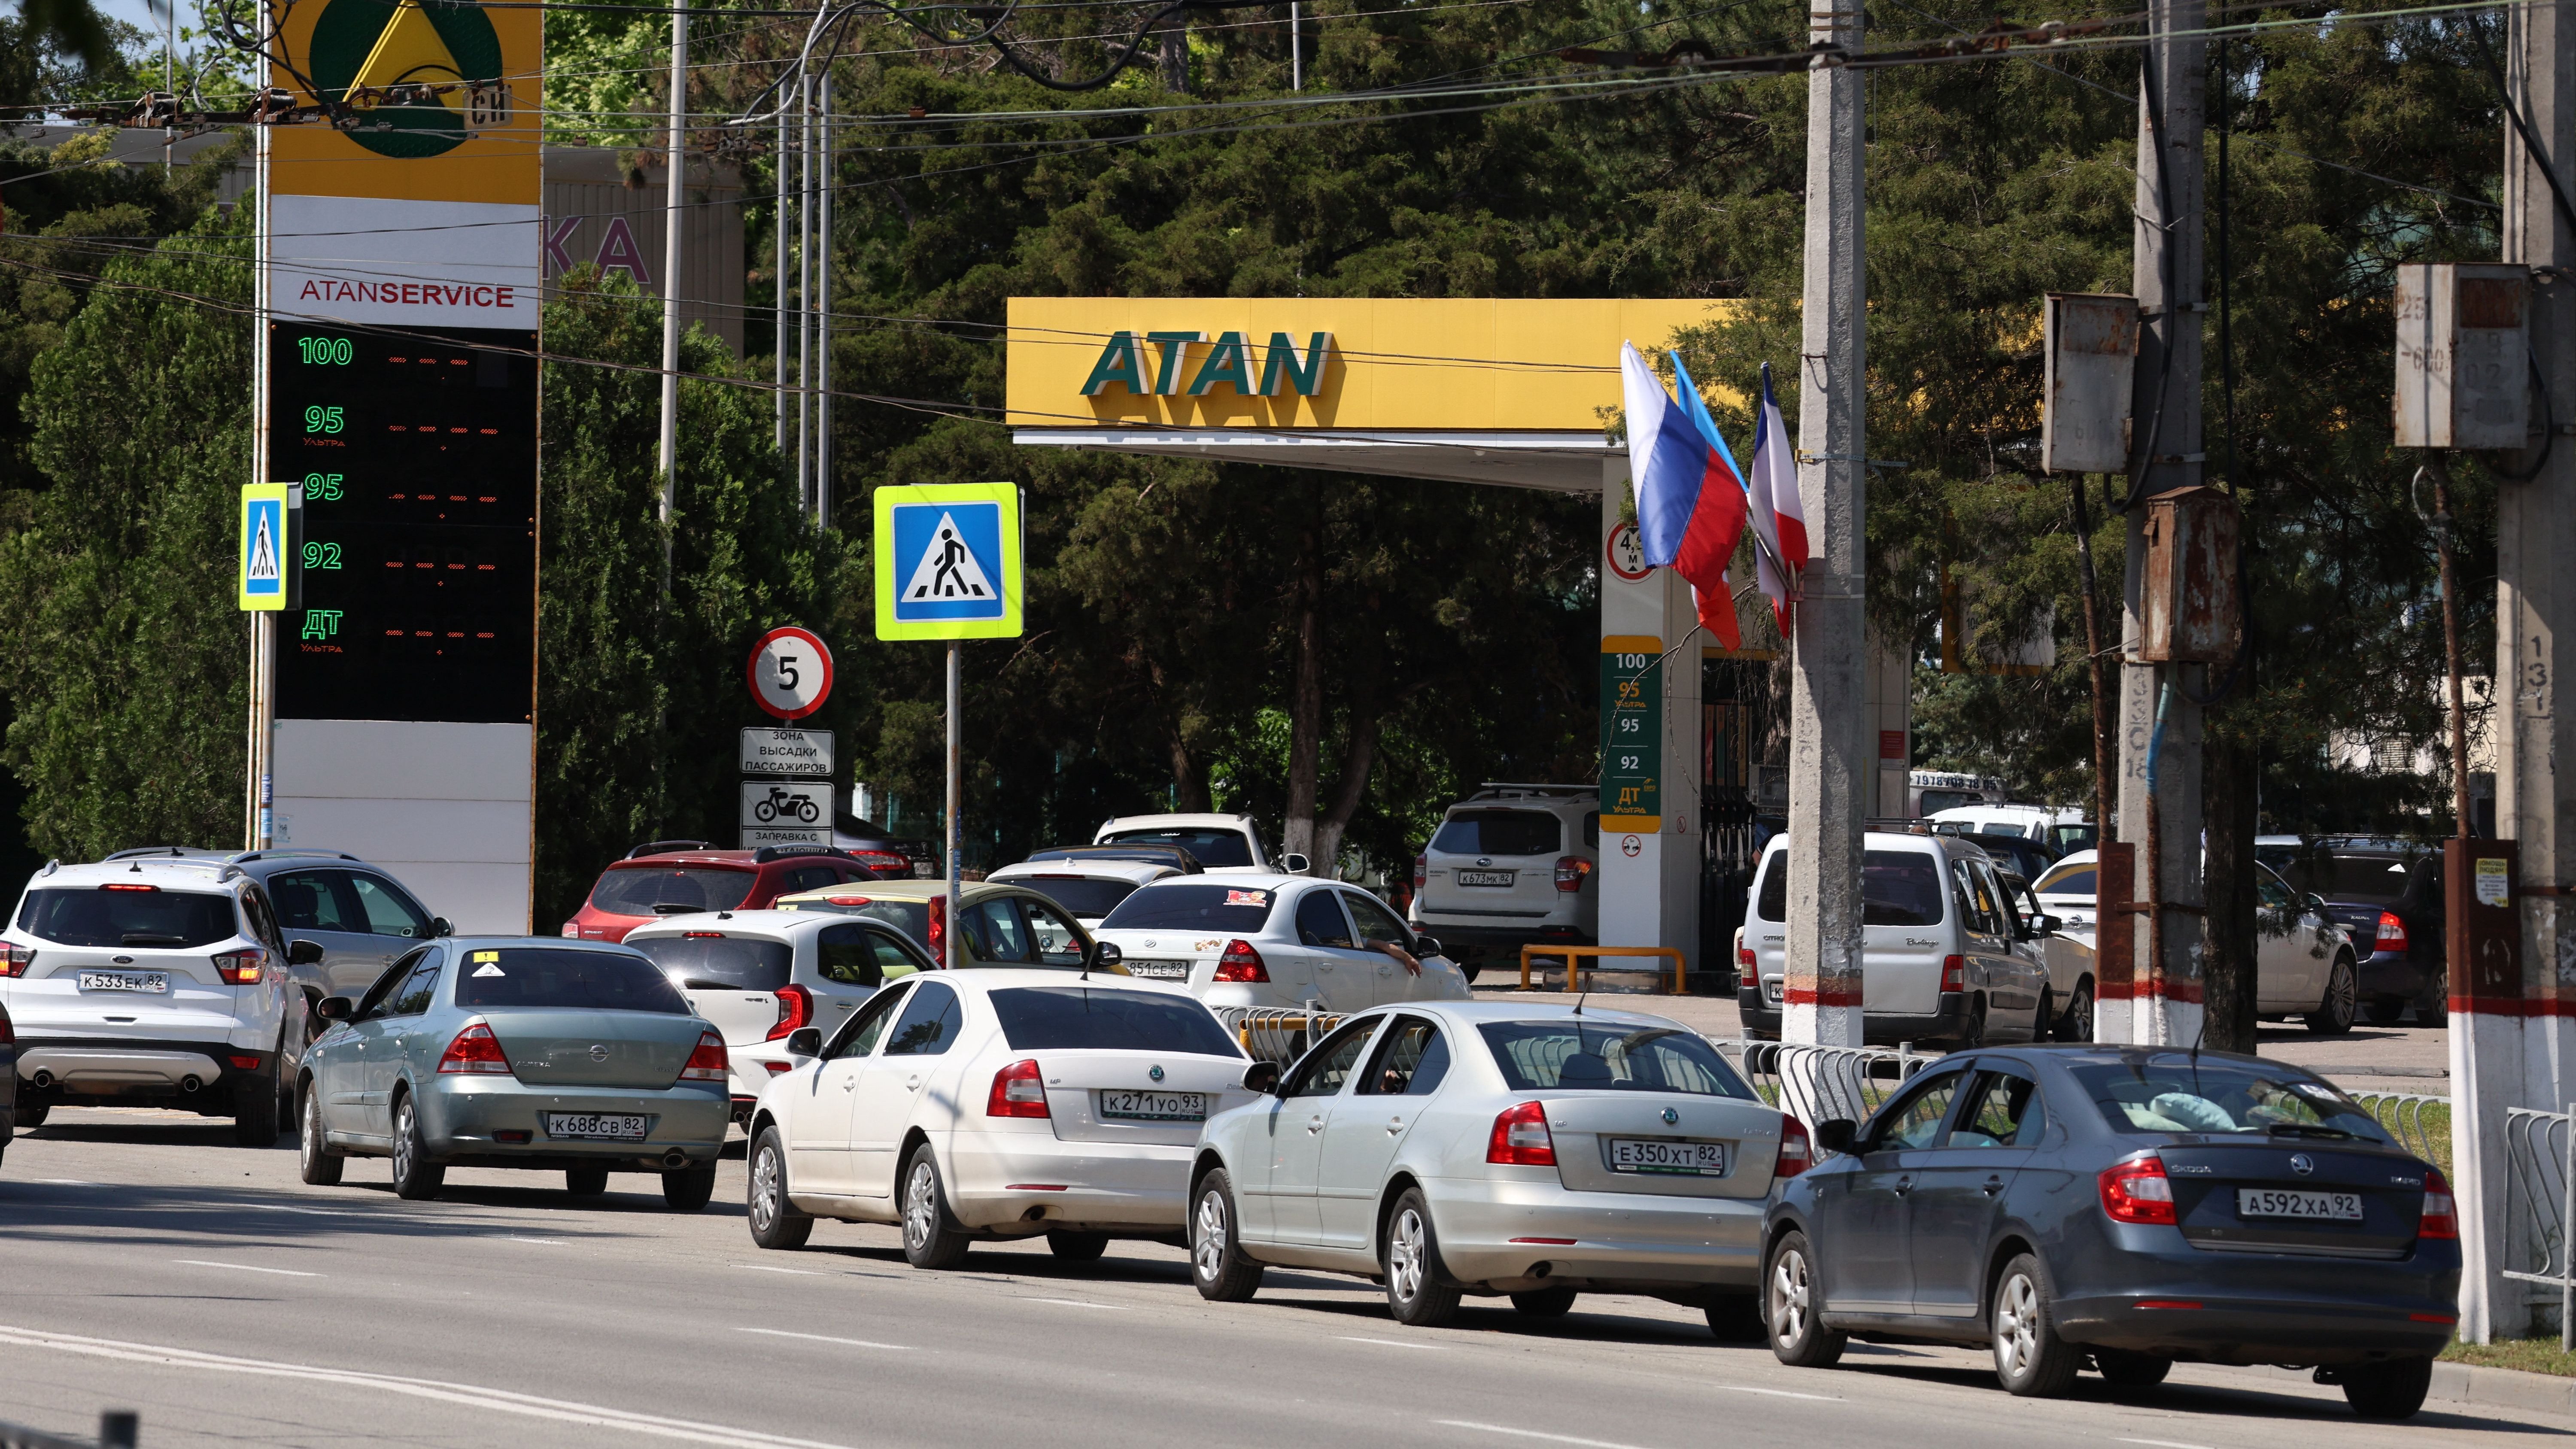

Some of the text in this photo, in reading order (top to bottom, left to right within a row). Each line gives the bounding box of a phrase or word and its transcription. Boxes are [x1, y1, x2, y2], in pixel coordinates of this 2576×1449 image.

[300, 280, 514, 307] ATANSERVICE
[298, 337, 352, 365] 100
[1079, 331, 1333, 395] ATAN
[305, 406, 344, 433] 95
[303, 437, 345, 447] УЛЬТРА
[304, 474, 343, 501] 95
[303, 542, 342, 569] 92
[302, 610, 343, 640] ДТ
[301, 644, 343, 653] УЛЬТРА
[1616, 653, 1645, 668] 100
[778, 656, 799, 690] 5
[1619, 682, 1640, 697] 95
[1621, 718, 1639, 732] 95
[773, 732, 804, 741] ЗОНА
[760, 746, 817, 757] ВЫСАДКИ
[745, 762, 826, 772] ПАССАЖИРОВ
[1621, 756, 1639, 770] 92
[1619, 787, 1640, 805] ДТ
[1613, 805, 1646, 814] УЛЬТРА
[756, 832, 807, 841] ЗАПРАВКА
[1463, 873, 1509, 884] К673МК 82
[1130, 963, 1182, 975] 851СЕ 82
[85, 974, 162, 989] К533ЕК 82
[1109, 1094, 1199, 1112] К271УО 93
[556, 1117, 639, 1133] К688СВ 82
[1620, 1144, 1716, 1164] Е350ХТ 82
[2171, 1164, 2212, 1174] ŠKODA
[2249, 1193, 2354, 1216] А592ХА 92
